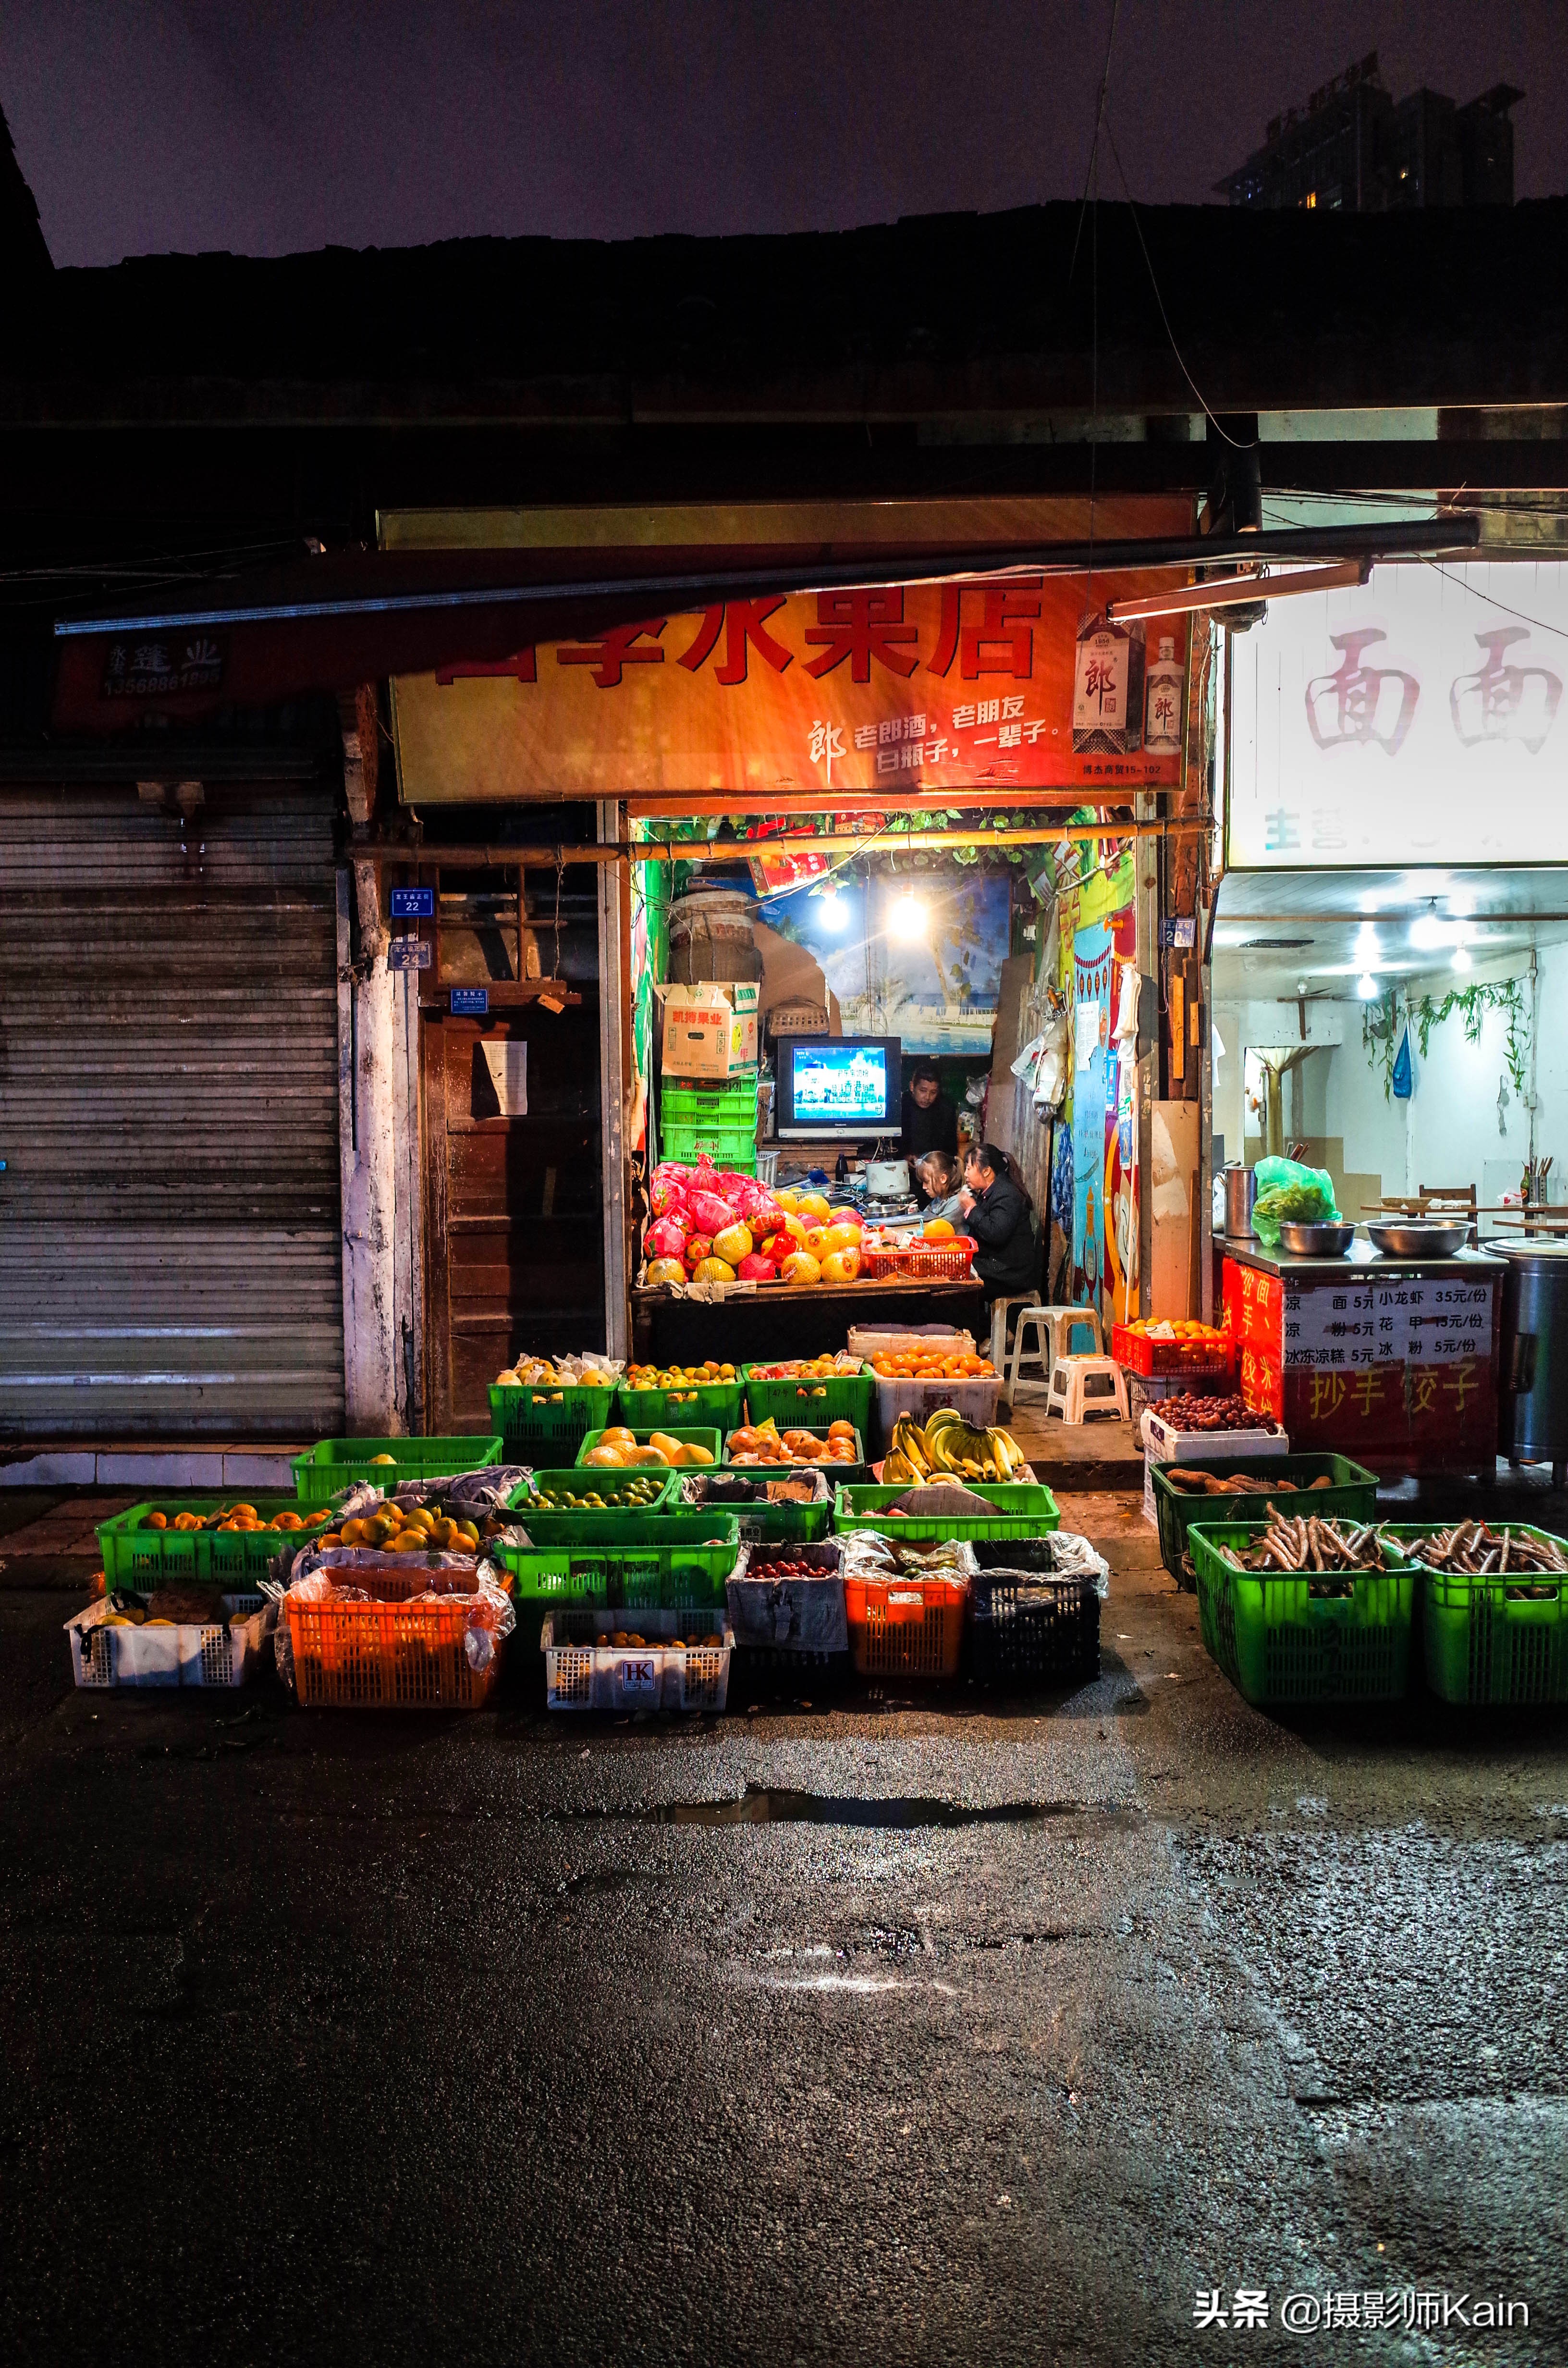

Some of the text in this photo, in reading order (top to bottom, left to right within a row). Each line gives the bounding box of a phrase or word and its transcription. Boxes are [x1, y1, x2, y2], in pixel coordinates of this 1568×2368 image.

[1085, 658, 1116, 716] 郎
[1155, 697, 1174, 730] 郎
[808, 719, 847, 784] 郎
[406, 902, 419, 911] 22
[1166, 931, 1182, 943] 20
[402, 954, 420, 966] 24
[1286, 1295, 1373, 1310] 凉 面 5元
[1379, 1288, 1487, 1306] 小龙虾 35元/份
[1286, 1321, 1373, 1337] 凉 粉 5元
[1379, 1316, 1393, 1331] 花
[1409, 1316, 1422, 1330] 甲
[1379, 1339, 1476, 1356] 冰 粉 5元/份
[1285, 1348, 1373, 1364] 冰冻凉糕 5元
[1310, 1363, 1480, 1420] 抄手 饺子
[625, 1663, 652, 1681] HK
